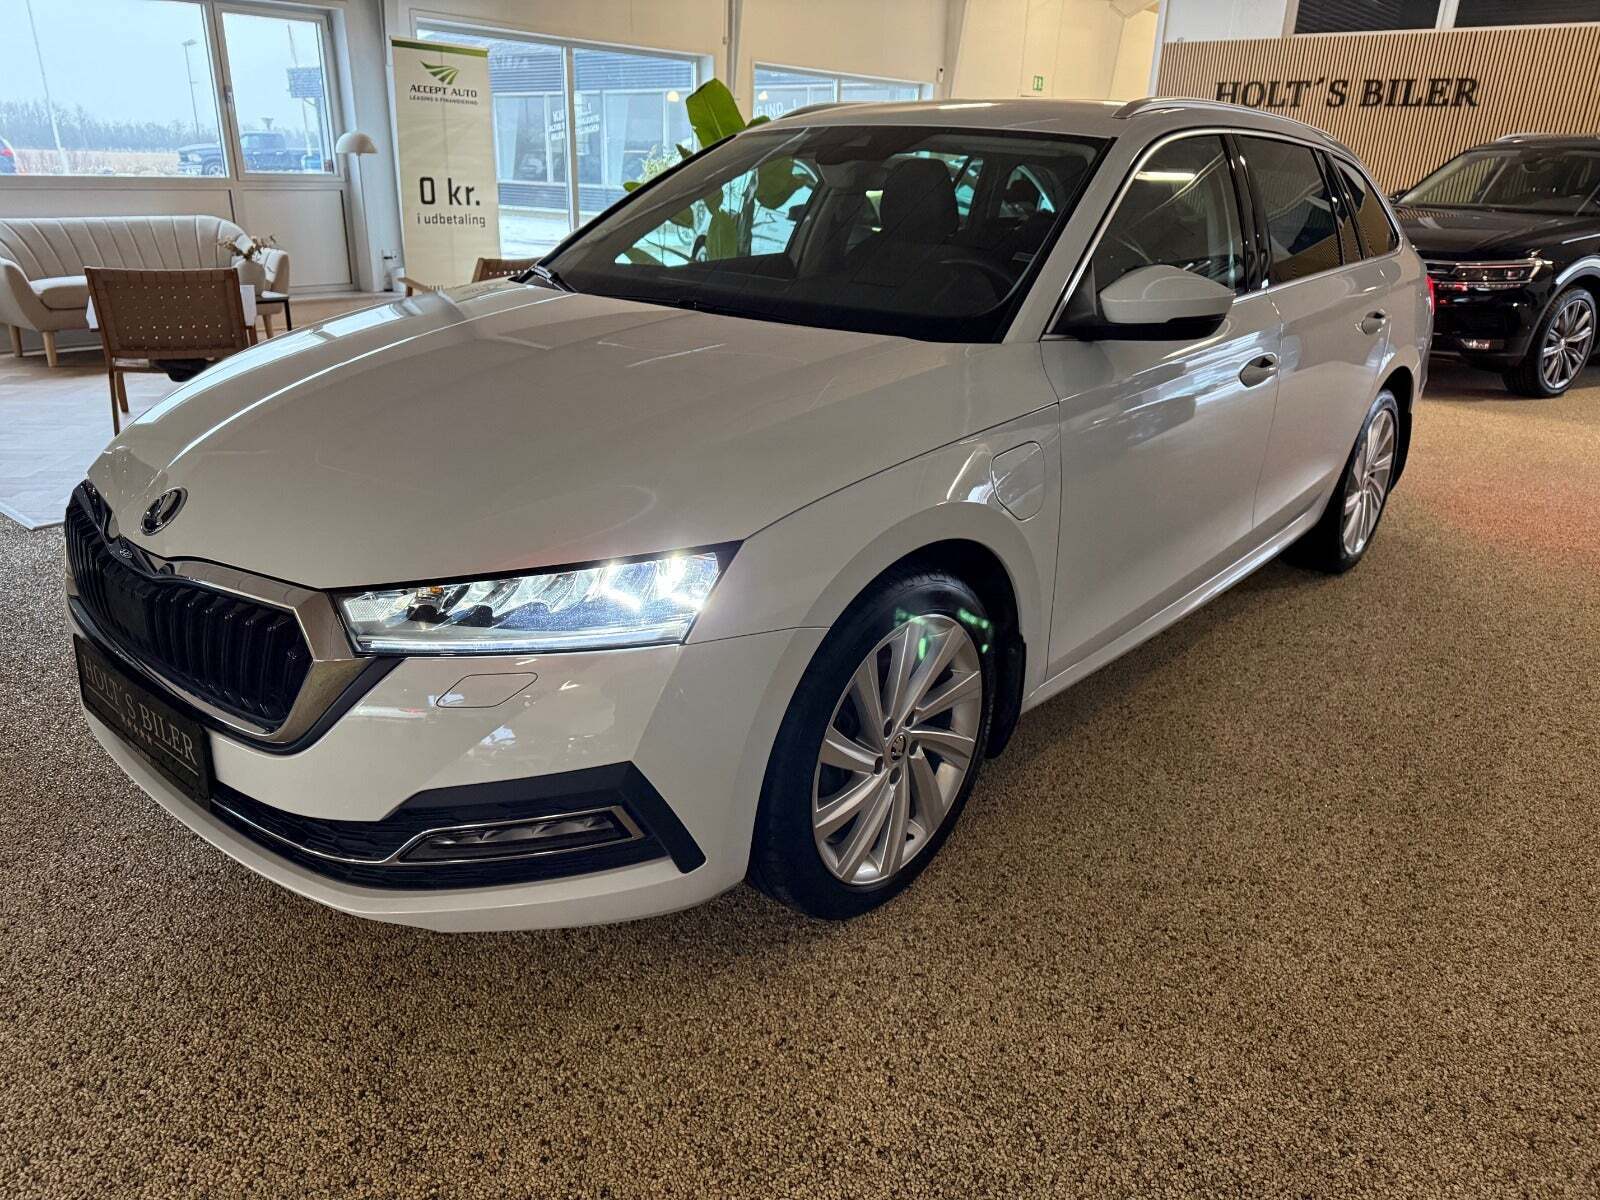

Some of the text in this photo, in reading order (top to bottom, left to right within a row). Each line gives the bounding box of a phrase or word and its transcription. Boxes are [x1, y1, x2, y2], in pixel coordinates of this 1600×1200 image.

[409, 84, 478, 98] ACCEPT AUTO
[1359, 77, 1479, 108] BILER
[419, 176, 481, 206] 0 kr.
[424, 213, 486, 228] udbetaling
[139, 703, 198, 766] BILER
